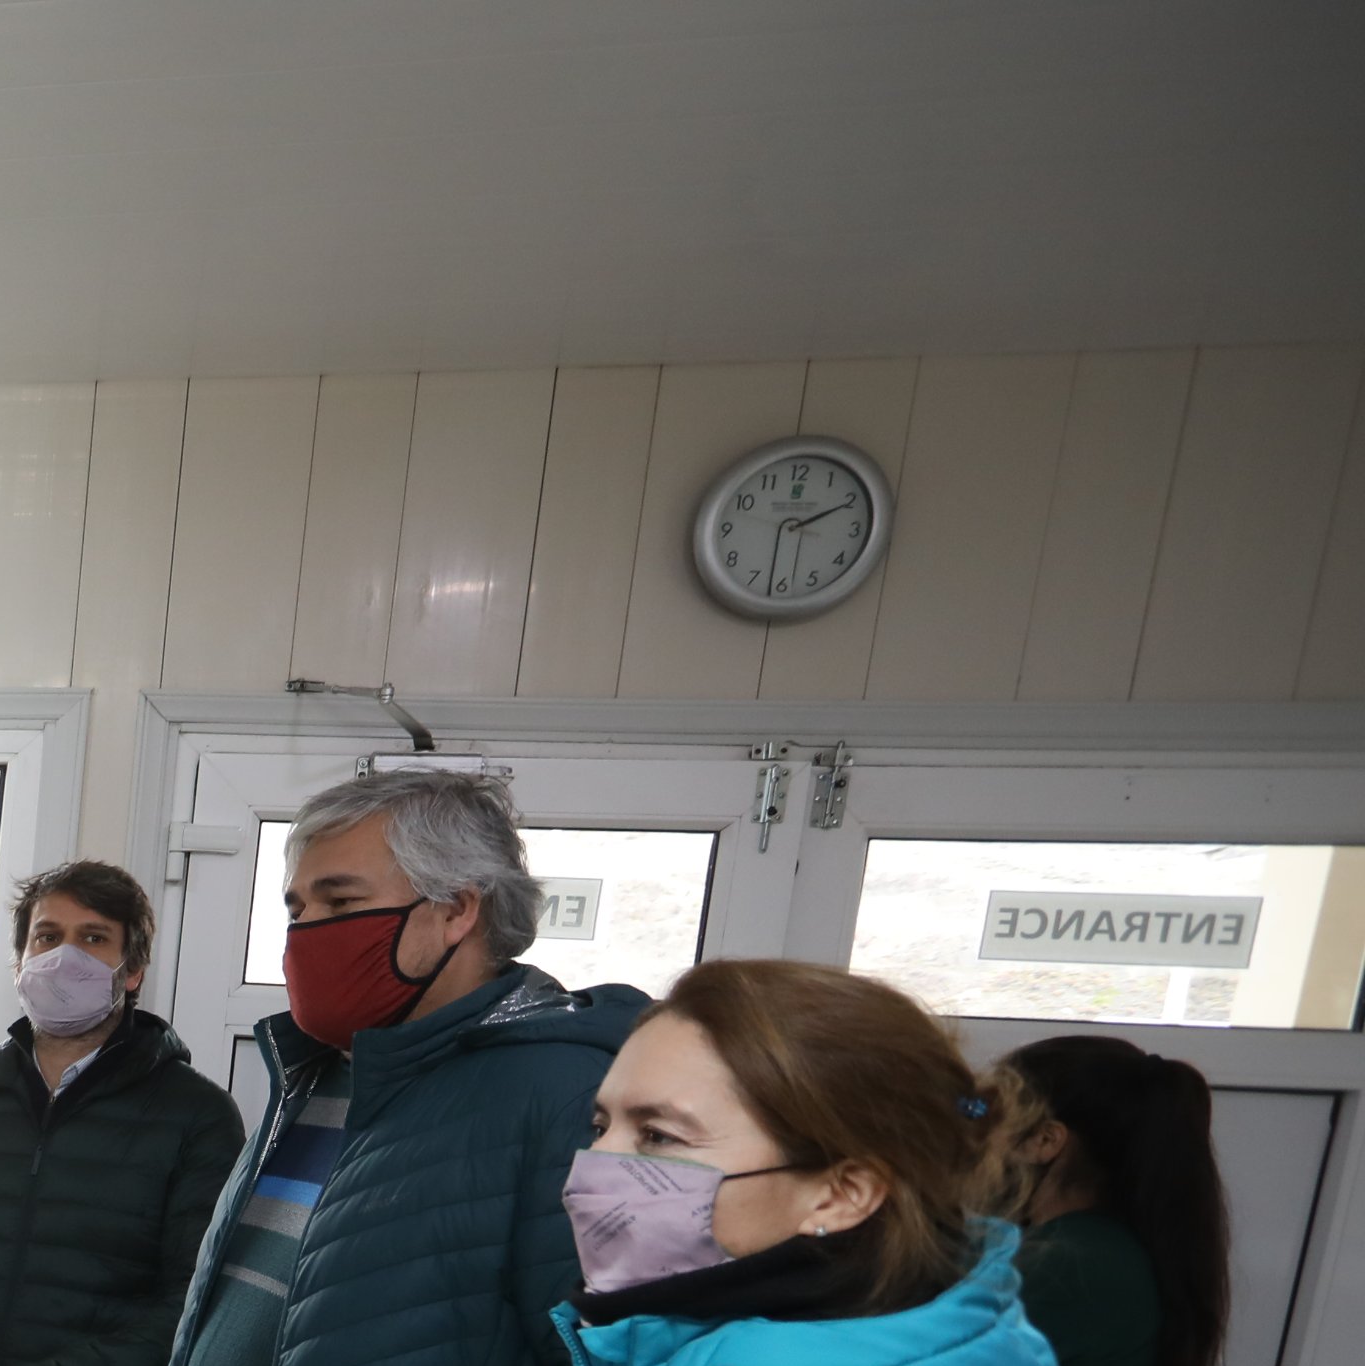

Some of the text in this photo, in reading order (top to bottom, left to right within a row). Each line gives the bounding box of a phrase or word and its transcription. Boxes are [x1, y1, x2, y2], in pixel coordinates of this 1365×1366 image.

[791, 464, 810, 481] 12
[828, 471, 834, 488] 1
[761, 474, 777, 491] 11
[736, 494, 755, 511] 10
[845, 492, 857, 509] 2
[721, 521, 733, 539] 9
[848, 521, 860, 538] 3
[726, 551, 739, 568] 8
[832, 551, 845, 566] 4
[747, 570, 761, 586] 7
[776, 577, 788, 593] 6
[806, 570, 818, 587] 5
